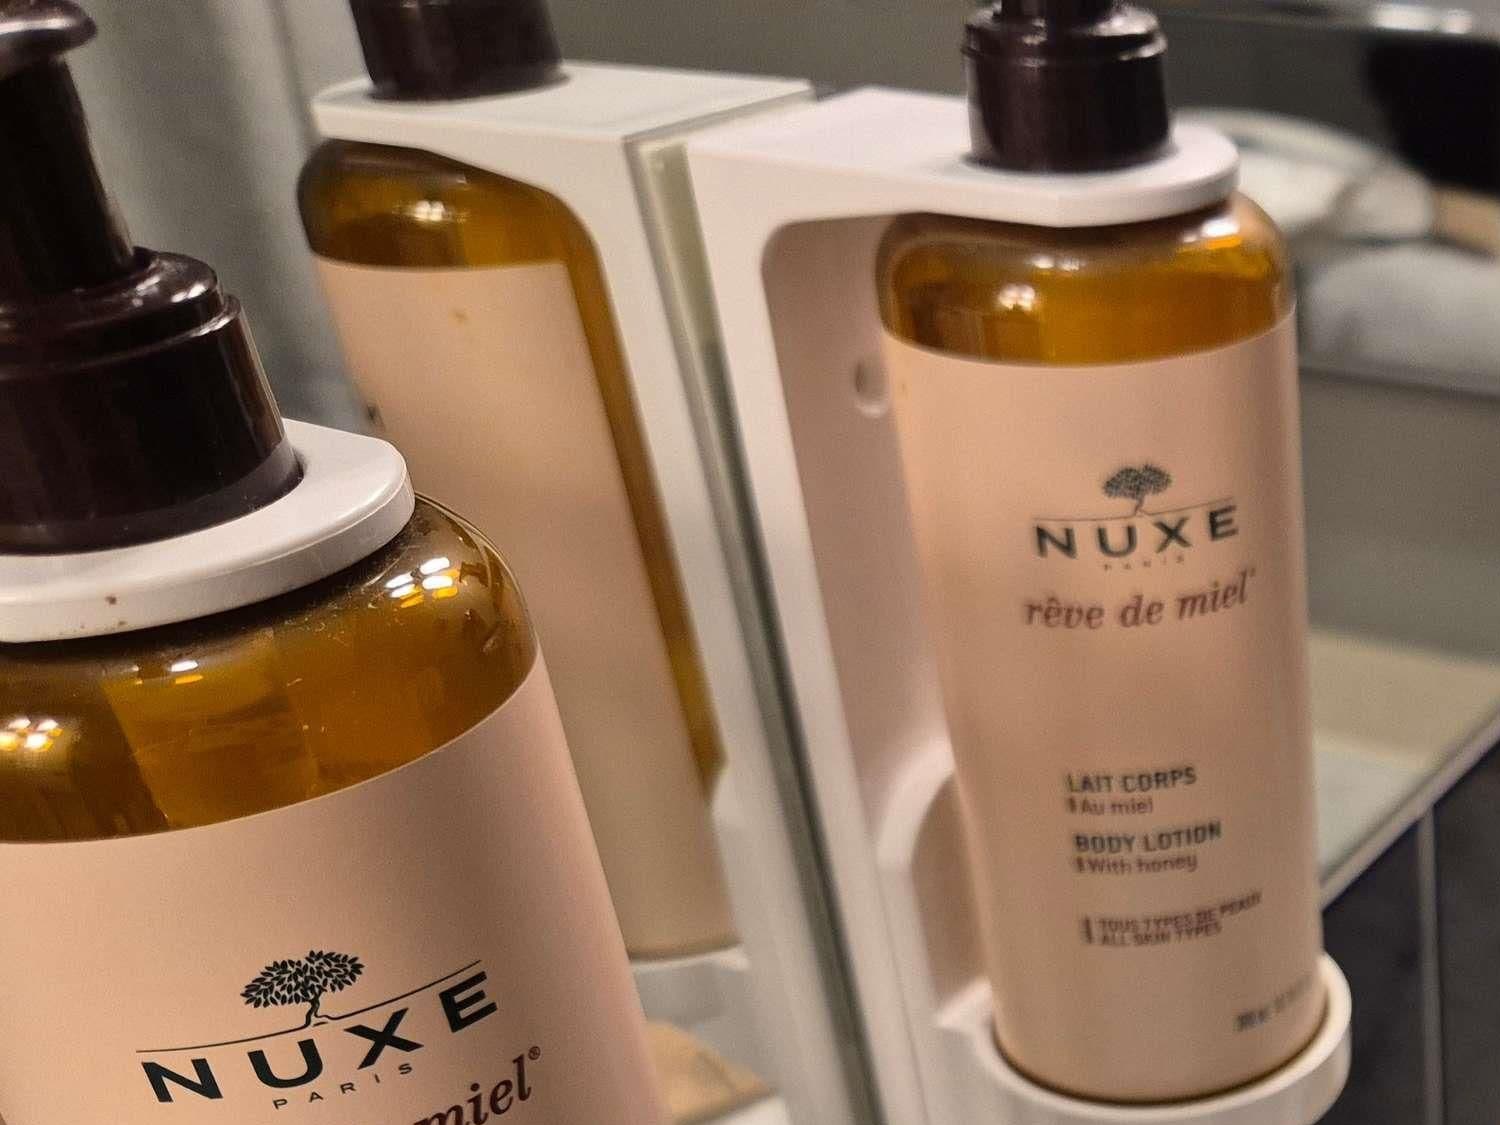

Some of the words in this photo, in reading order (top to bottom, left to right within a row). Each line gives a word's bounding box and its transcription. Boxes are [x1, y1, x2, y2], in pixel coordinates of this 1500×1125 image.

[1035, 504, 1239, 560] NUXE
[1024, 596, 1104, 629] rêve
[1119, 594, 1164, 628] de
[1067, 773, 1114, 793] LAIT
[1121, 766, 1197, 793] CORPS
[1081, 798, 1105, 815] Au
[1111, 798, 1153, 815] miel
[1075, 833, 1135, 854] BODY
[1144, 820, 1222, 851] LOTION
[1088, 858, 1132, 874] With
[1137, 854, 1198, 873] honey
[141, 970, 498, 1103] NUXE
[272, 1062, 413, 1111] PARIS
